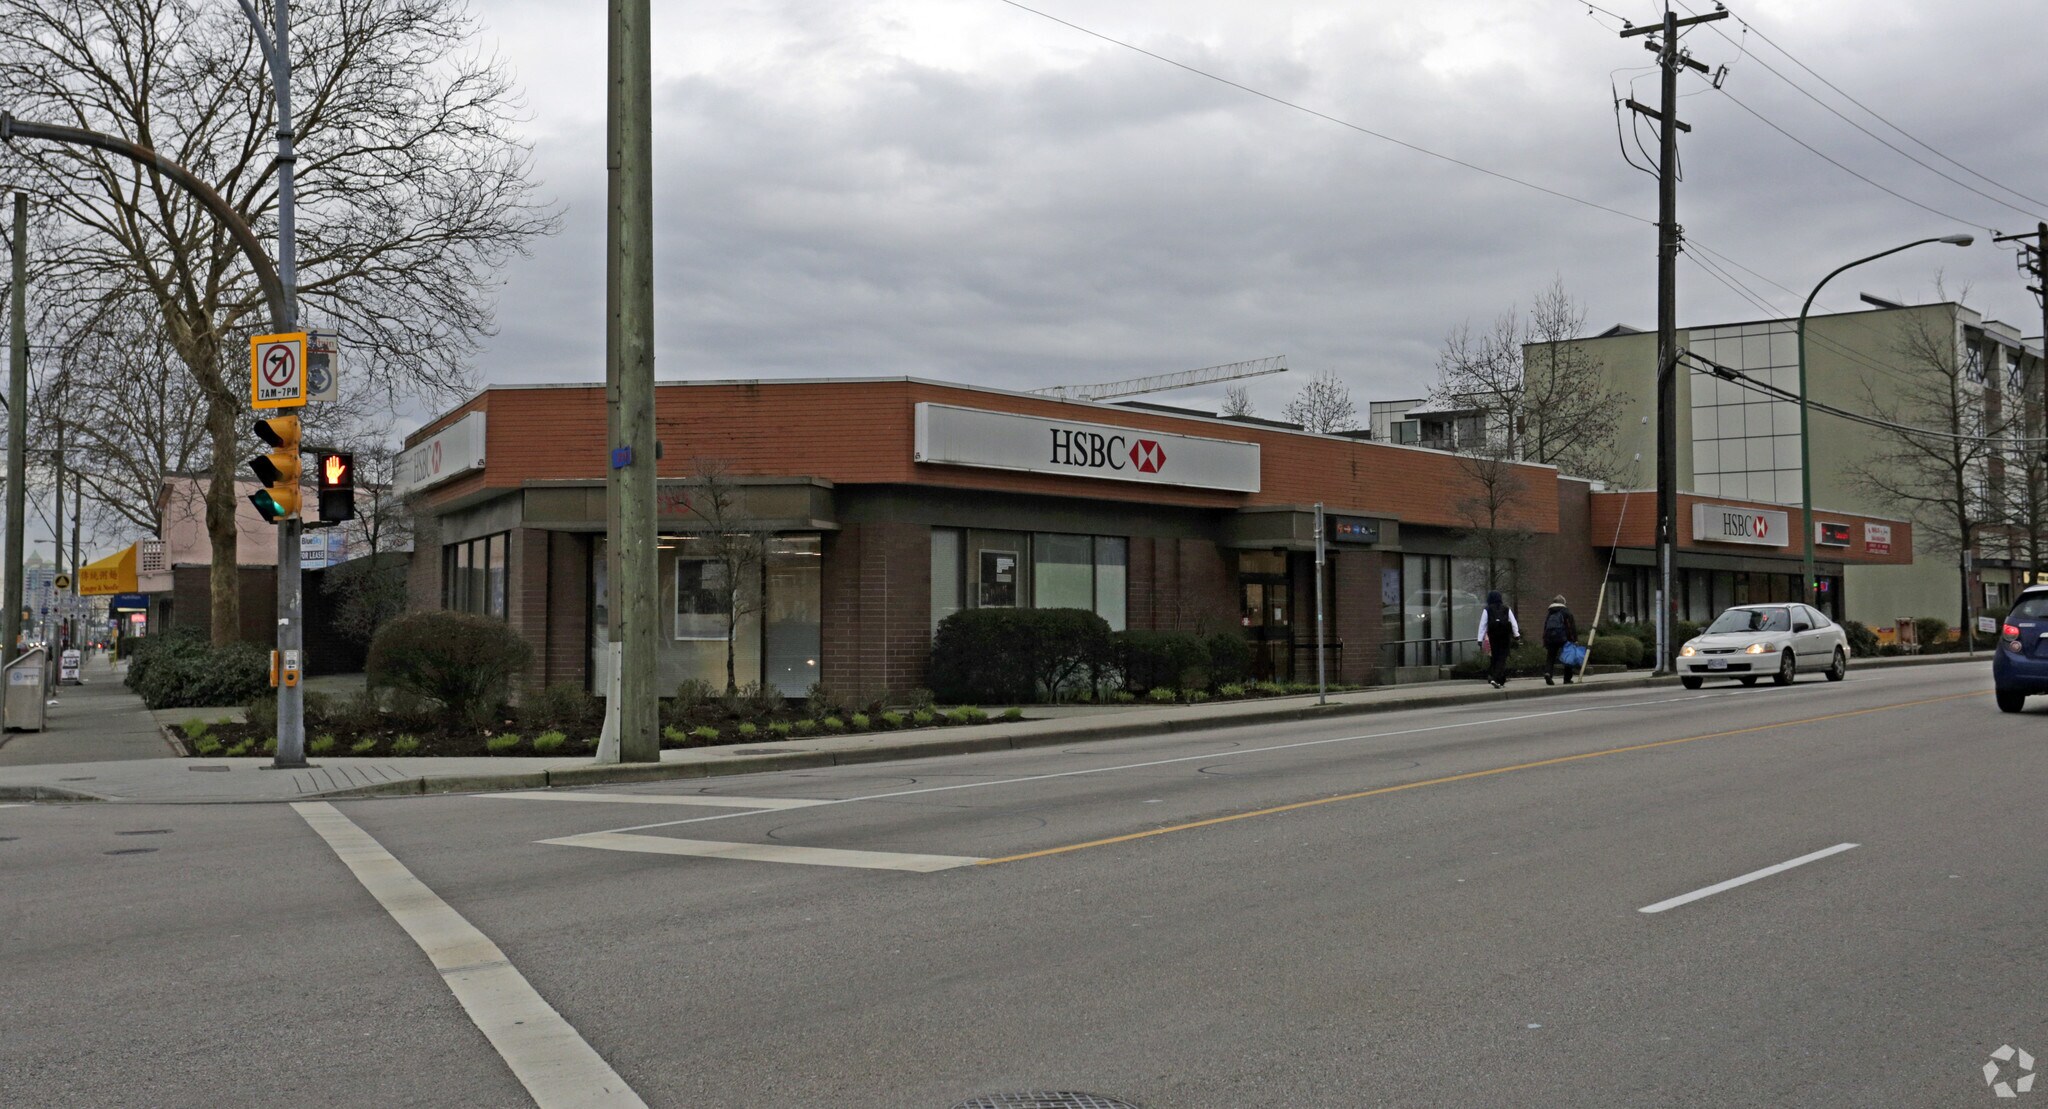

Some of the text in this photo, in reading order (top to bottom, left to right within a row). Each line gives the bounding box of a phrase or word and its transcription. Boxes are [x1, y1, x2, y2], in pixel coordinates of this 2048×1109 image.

[414, 445, 431, 483] HSBC
[1050, 428, 1126, 470] HSBC
[1723, 513, 1752, 537] HSBC
[301, 551, 324, 560] OR LEASE
